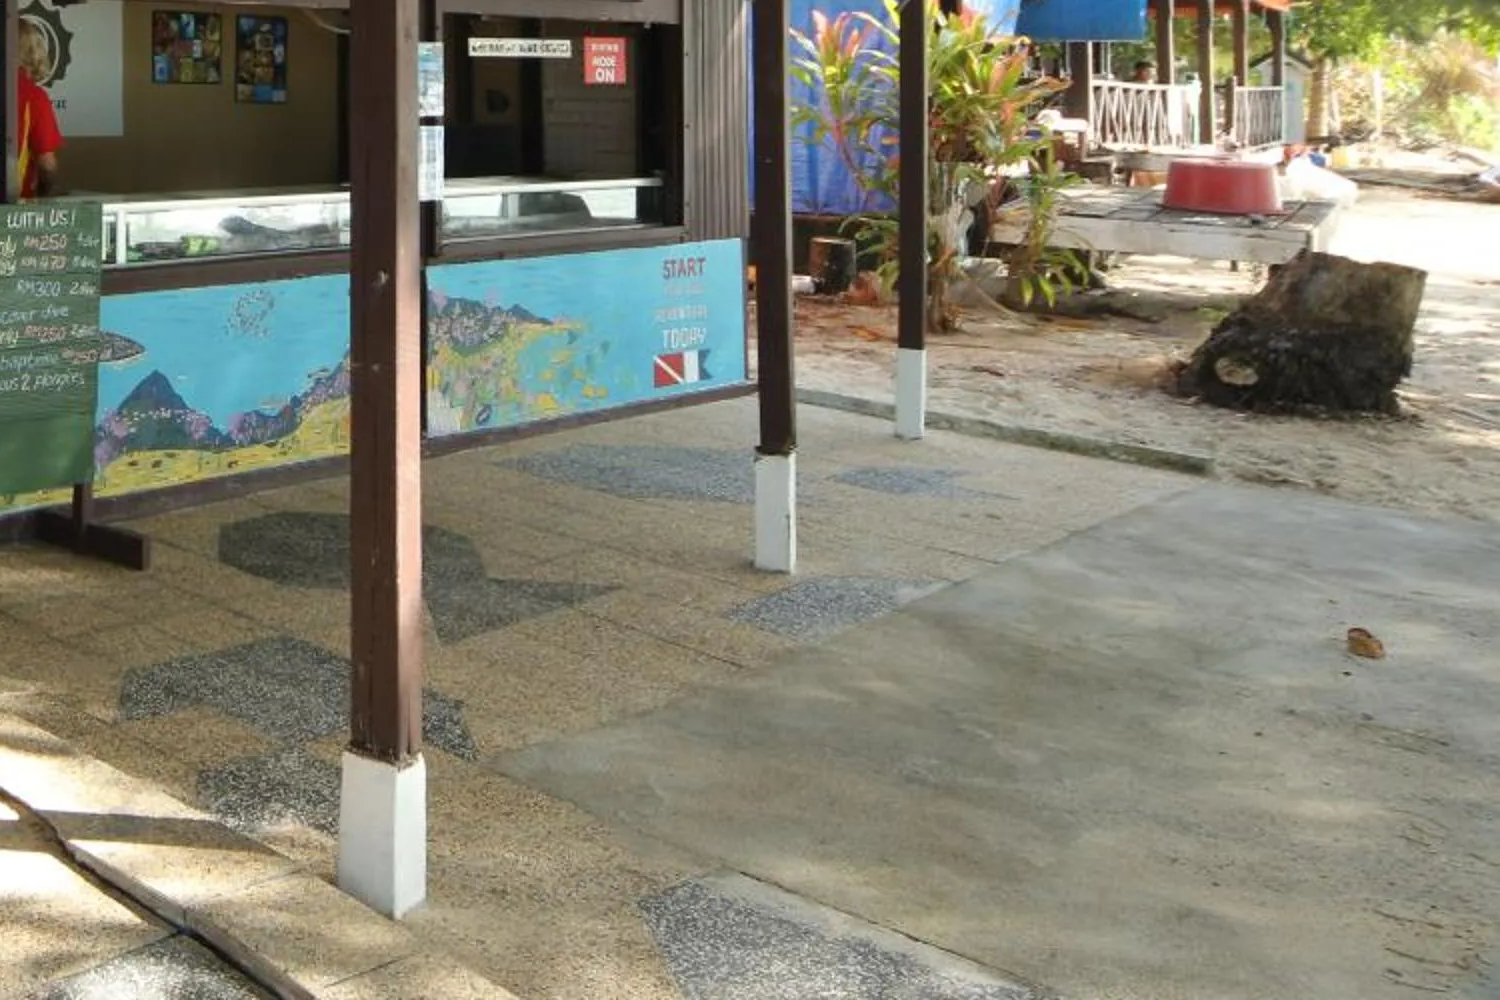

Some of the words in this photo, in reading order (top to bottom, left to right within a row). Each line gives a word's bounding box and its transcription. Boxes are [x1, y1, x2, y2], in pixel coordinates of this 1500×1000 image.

[596, 68, 615, 83] ON
[7, 211, 44, 229] WITH
[663, 256, 707, 280] START
[661, 327, 707, 350] TODAY
